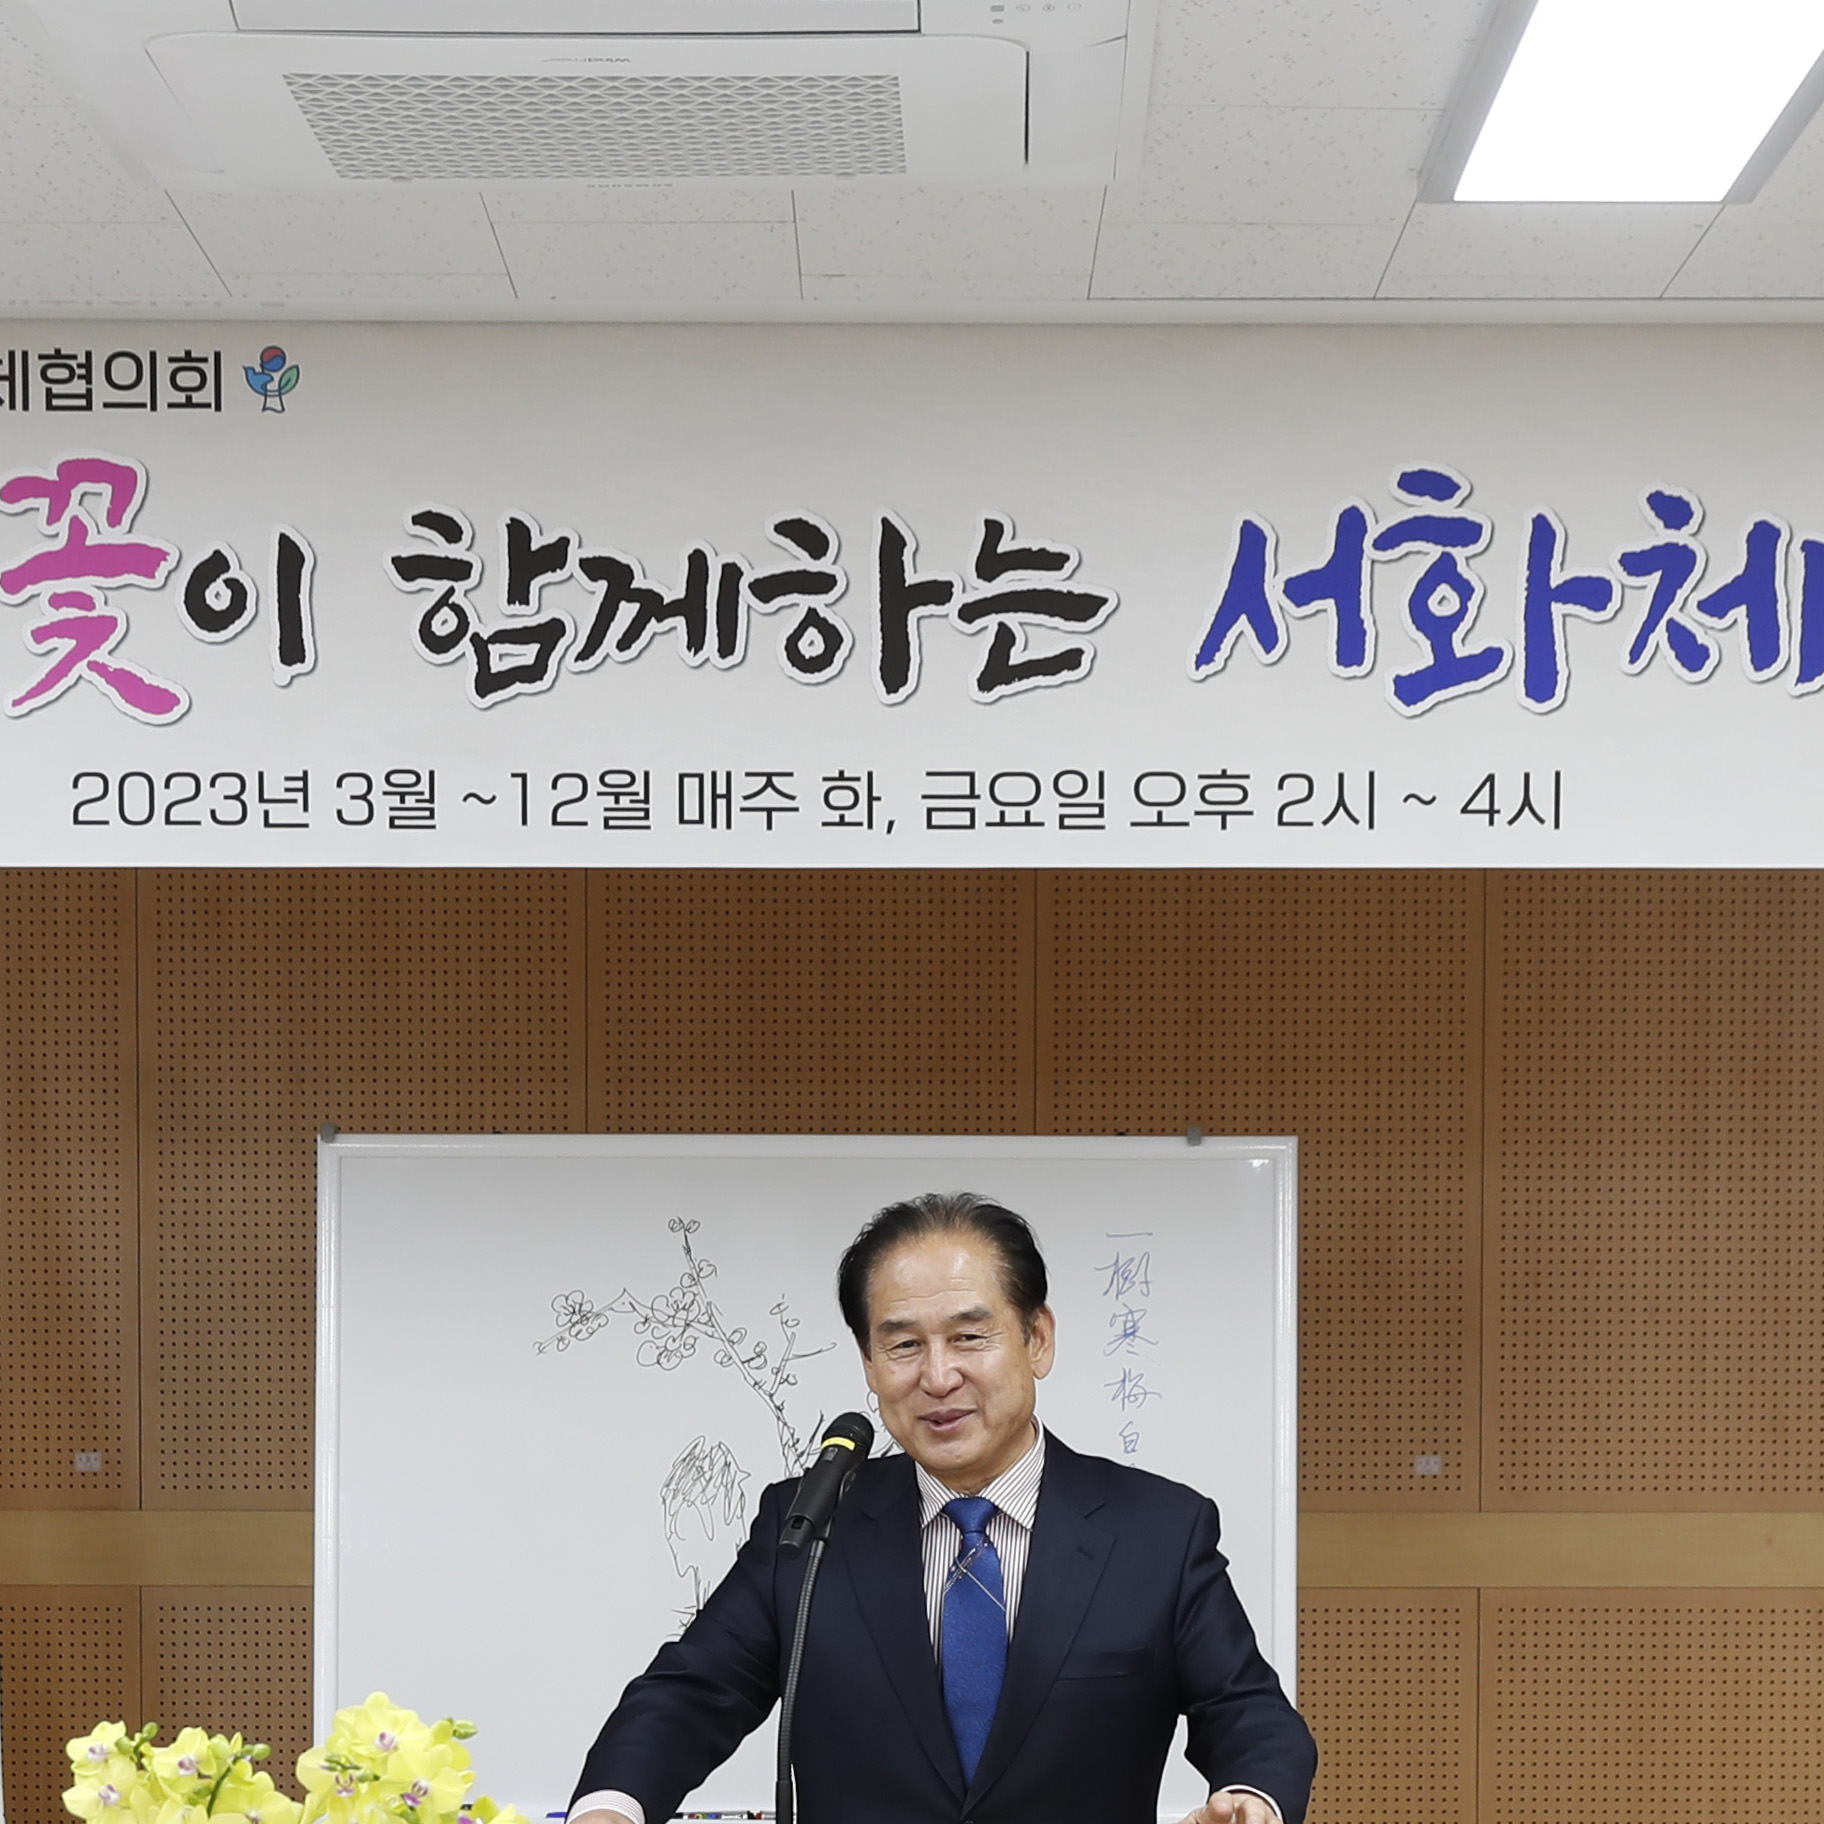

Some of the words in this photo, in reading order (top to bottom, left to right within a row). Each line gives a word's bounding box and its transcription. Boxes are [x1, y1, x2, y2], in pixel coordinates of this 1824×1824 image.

[0, 458, 315, 715] 꽃이
[391, 509, 1117, 698] 함께하는
[72, 769, 310, 829] 2023년
[336, 768, 437, 830] 3월
[678, 770, 800, 831] 매주
[821, 769, 895, 835] 화,
[920, 769, 1106, 830] 금요일
[1129, 768, 1254, 831] 오후
[1277, 770, 1375, 830] 2시
[1460, 770, 1561, 830] 4시
[1093, 1231, 1163, 1468] 一樹寒梅白
